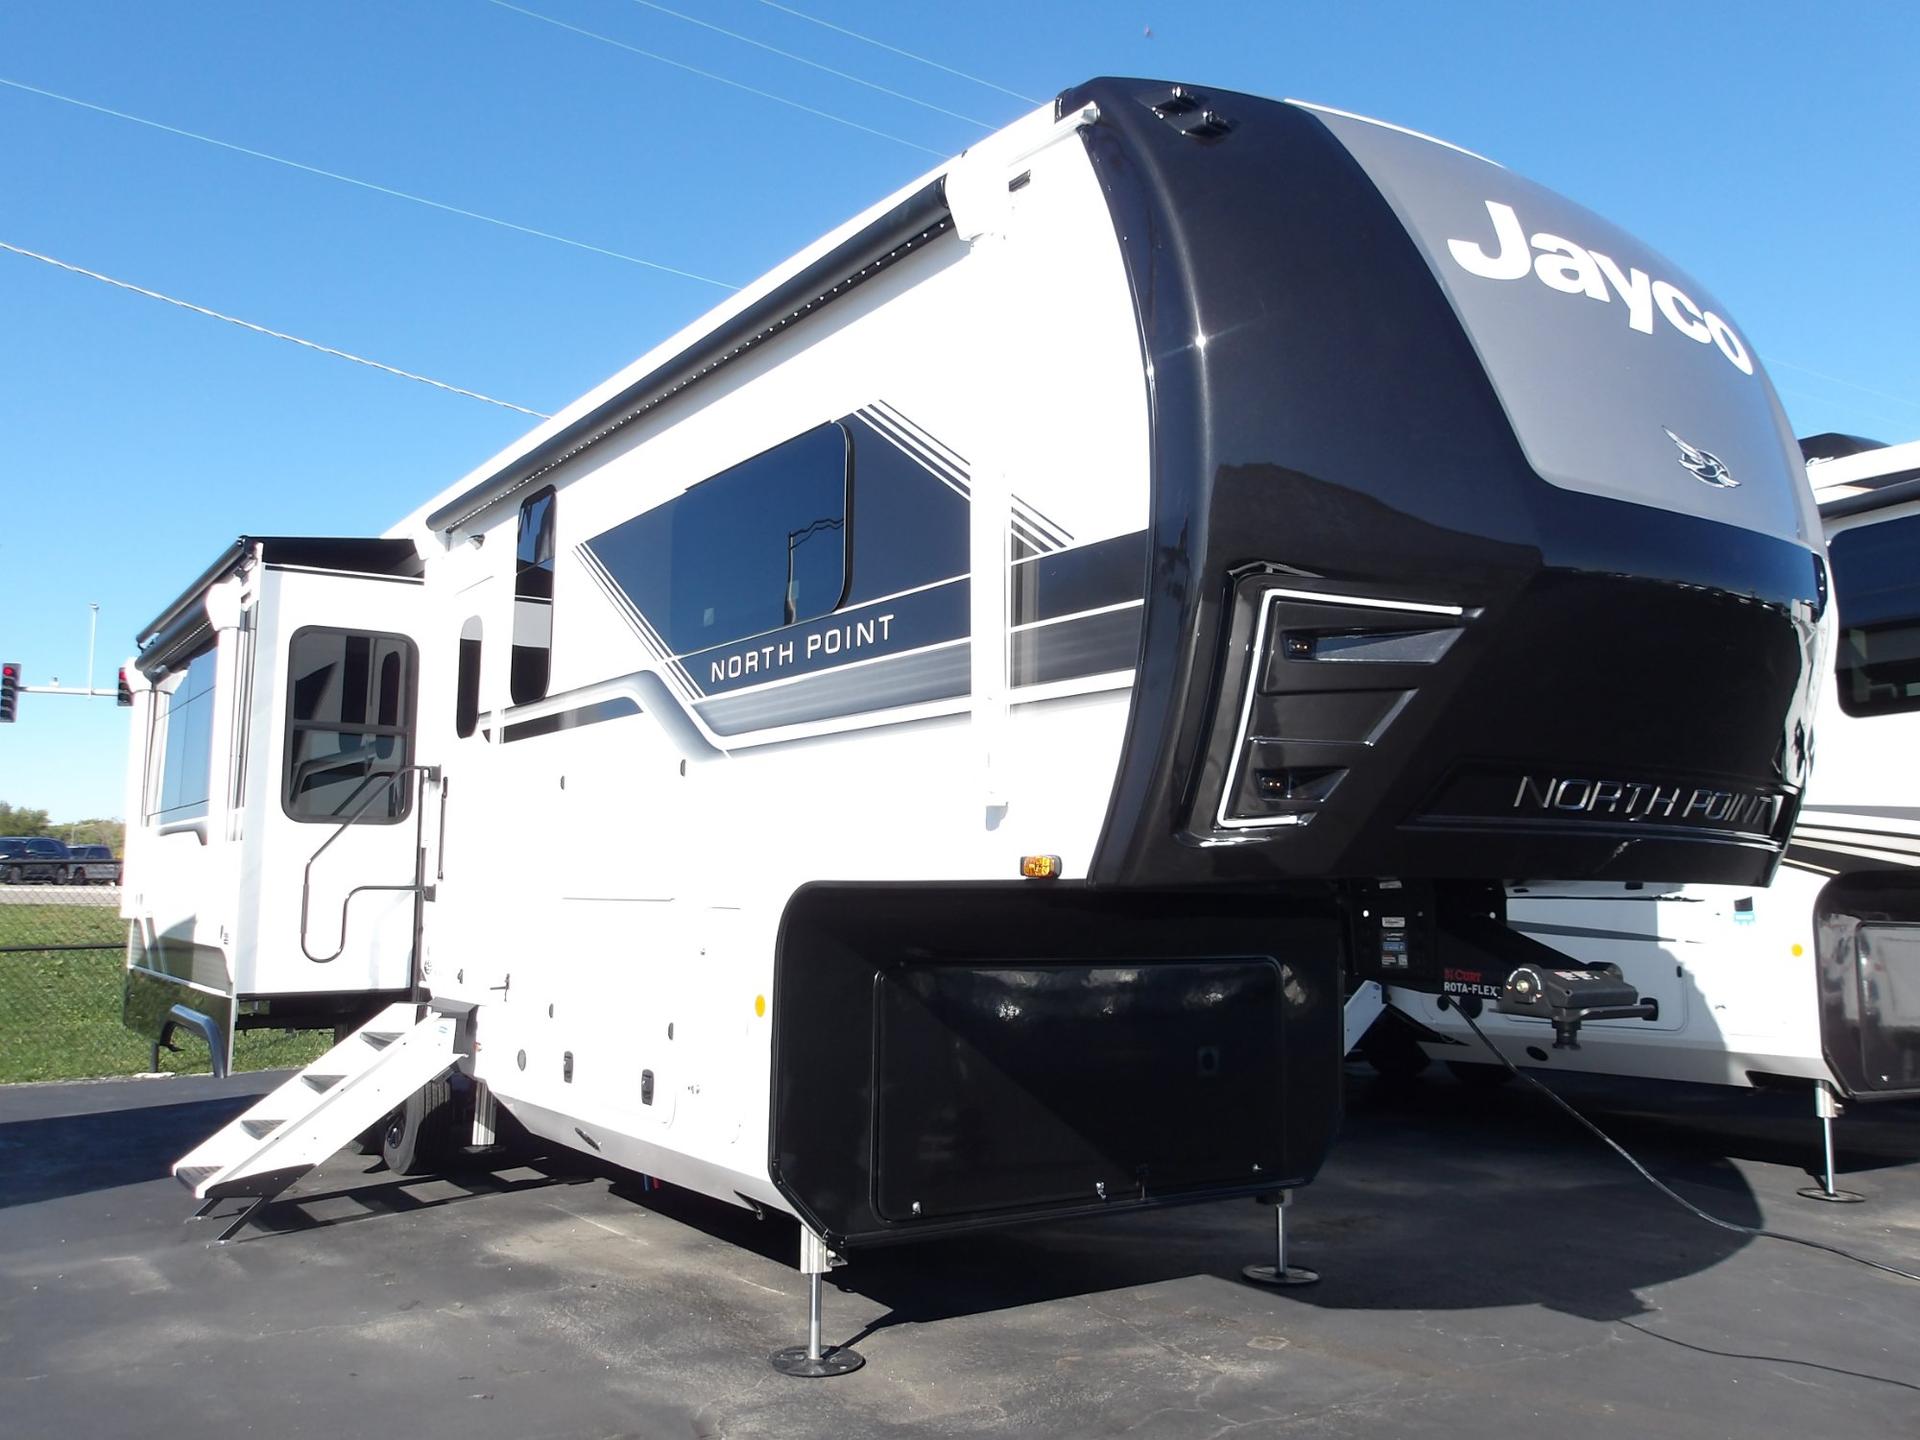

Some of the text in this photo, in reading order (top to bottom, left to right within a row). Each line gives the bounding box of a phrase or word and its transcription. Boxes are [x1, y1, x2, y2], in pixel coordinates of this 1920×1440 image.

[1447, 200, 1753, 375] Jayco
[711, 614, 895, 683] NORTH POINT
[1513, 776, 1772, 825] NORTH POINT
[1444, 982, 1498, 997] ROTA-FLEX
